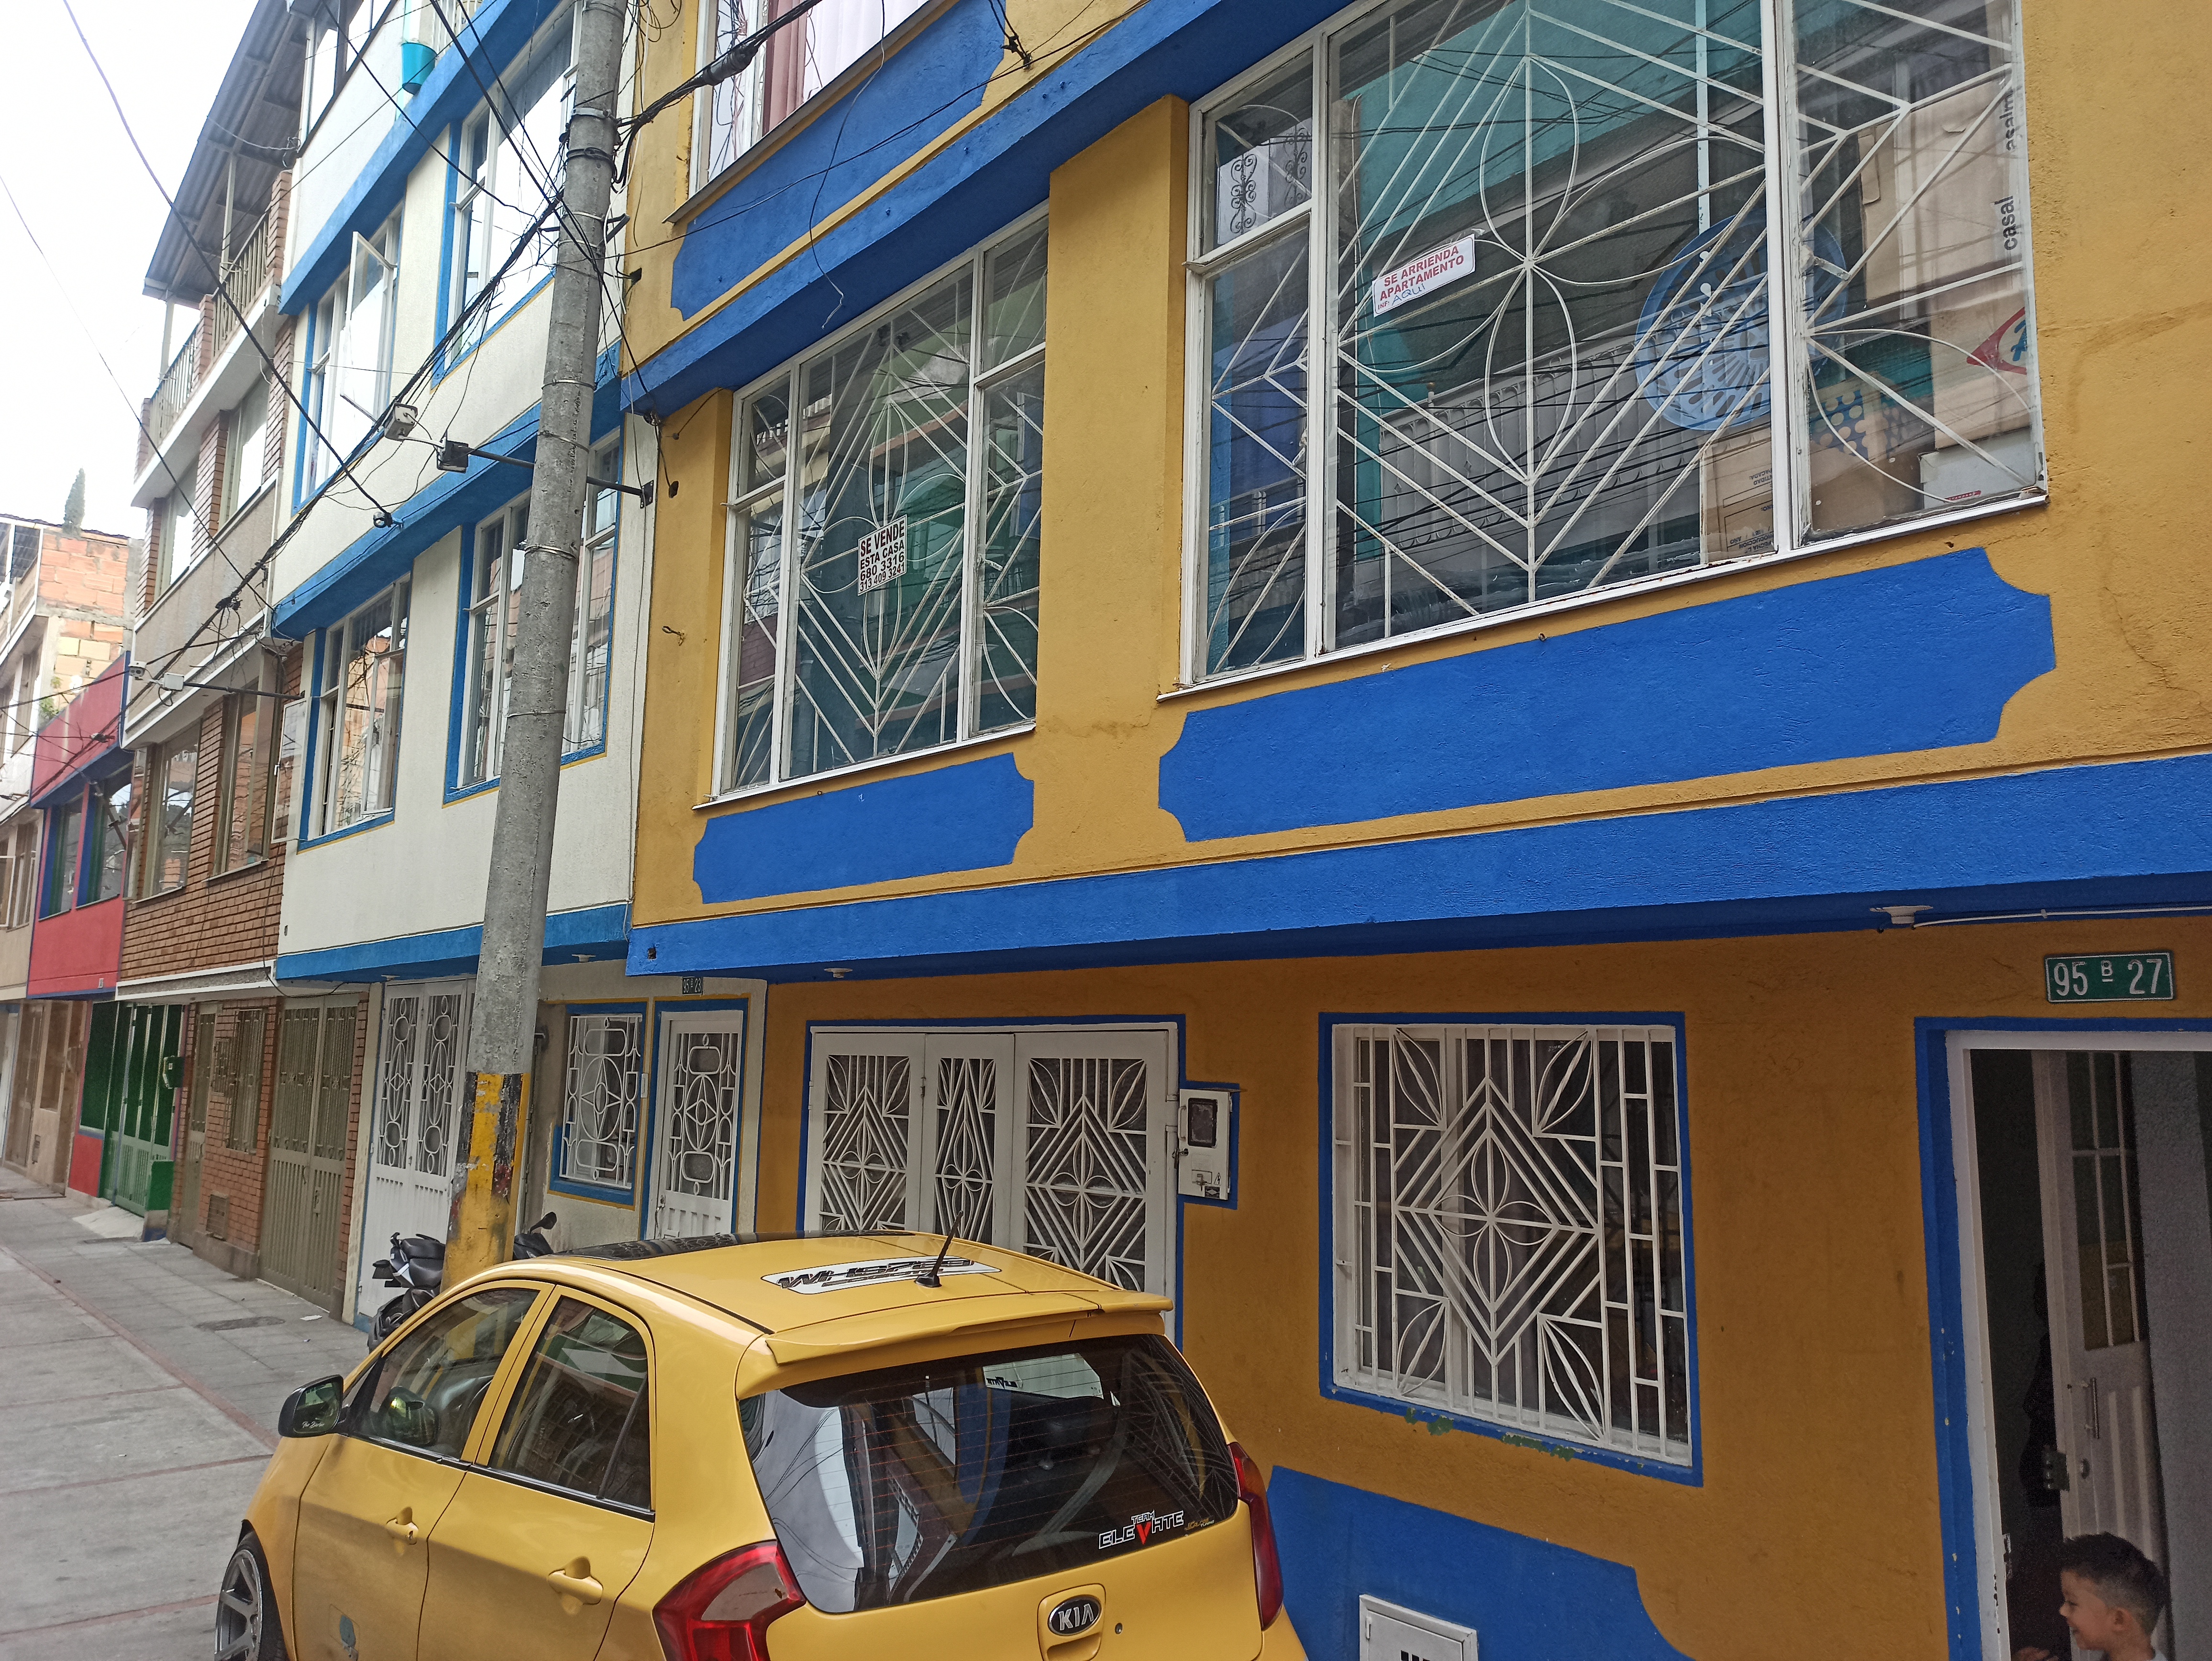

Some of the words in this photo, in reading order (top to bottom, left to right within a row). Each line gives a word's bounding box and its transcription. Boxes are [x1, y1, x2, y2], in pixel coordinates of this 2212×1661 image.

[1380, 255, 1464, 301] APARTAMENTO
[1384, 275, 1398, 287] SE
[1401, 246, 1459, 279] ARRIENDA
[1378, 301, 1389, 310] INF:
[860, 536, 872, 557] SE
[874, 520, 905, 550] VENDE
[1739, 533, 1774, 549] RODUCCION
[860, 552, 880, 570] ESTA
[882, 540, 905, 559] CASA
[860, 565, 877, 581] 680
[881, 552, 905, 572] 3316
[860, 578, 872, 591] 313
[874, 571, 886, 585] 409
[888, 562, 905, 578] 3241
[683, 979, 689, 993] 95
[695, 978, 701, 993] 23
[2054, 961, 2088, 997] 95
[2101, 960, 2113, 977] B
[2127, 958, 2163, 995] 27
[1098, 1510, 1184, 1550] ELEVATE
[1131, 1509, 1155, 1525] TEAM
[1058, 1604, 1094, 1631] KIA
